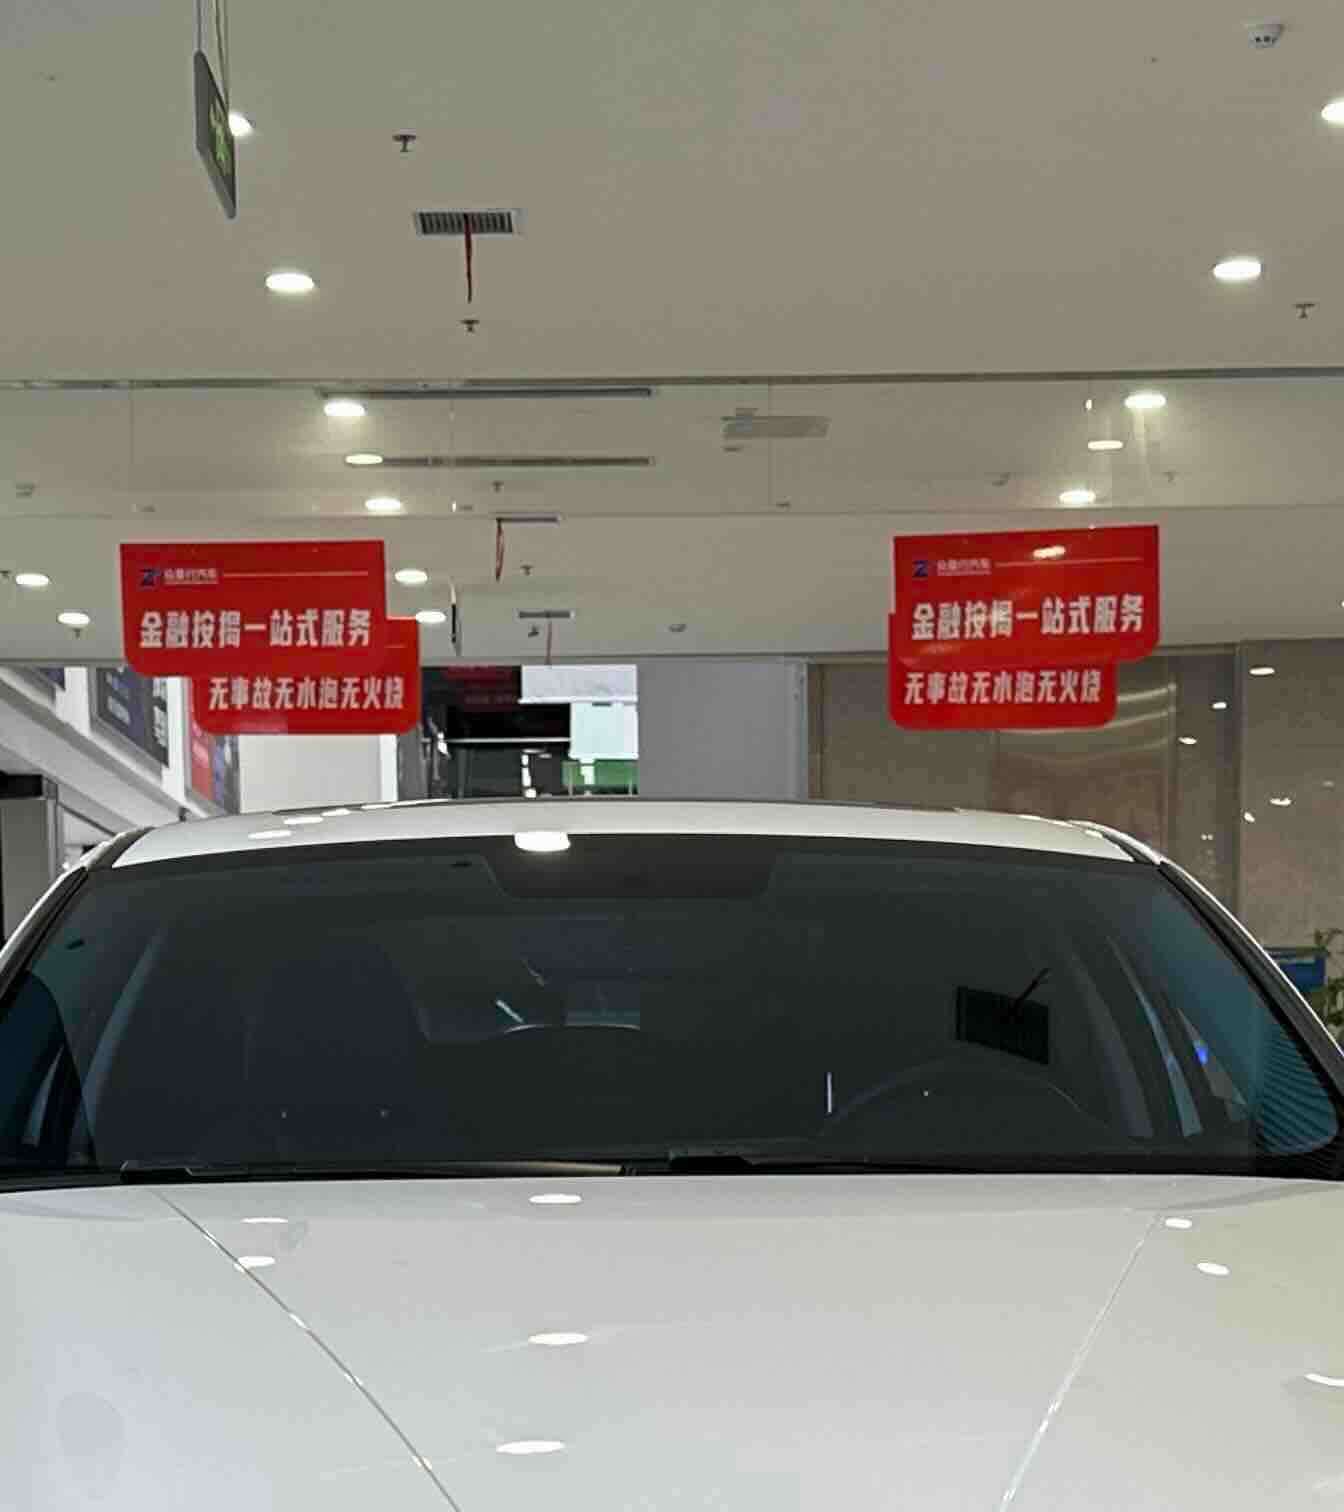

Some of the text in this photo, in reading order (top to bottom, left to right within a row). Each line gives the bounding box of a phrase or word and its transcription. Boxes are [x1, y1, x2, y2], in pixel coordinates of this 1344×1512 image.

[139, 608, 371, 649] 金融按揭一站式服务
[911, 594, 1144, 641] 金融按揭一站式服务
